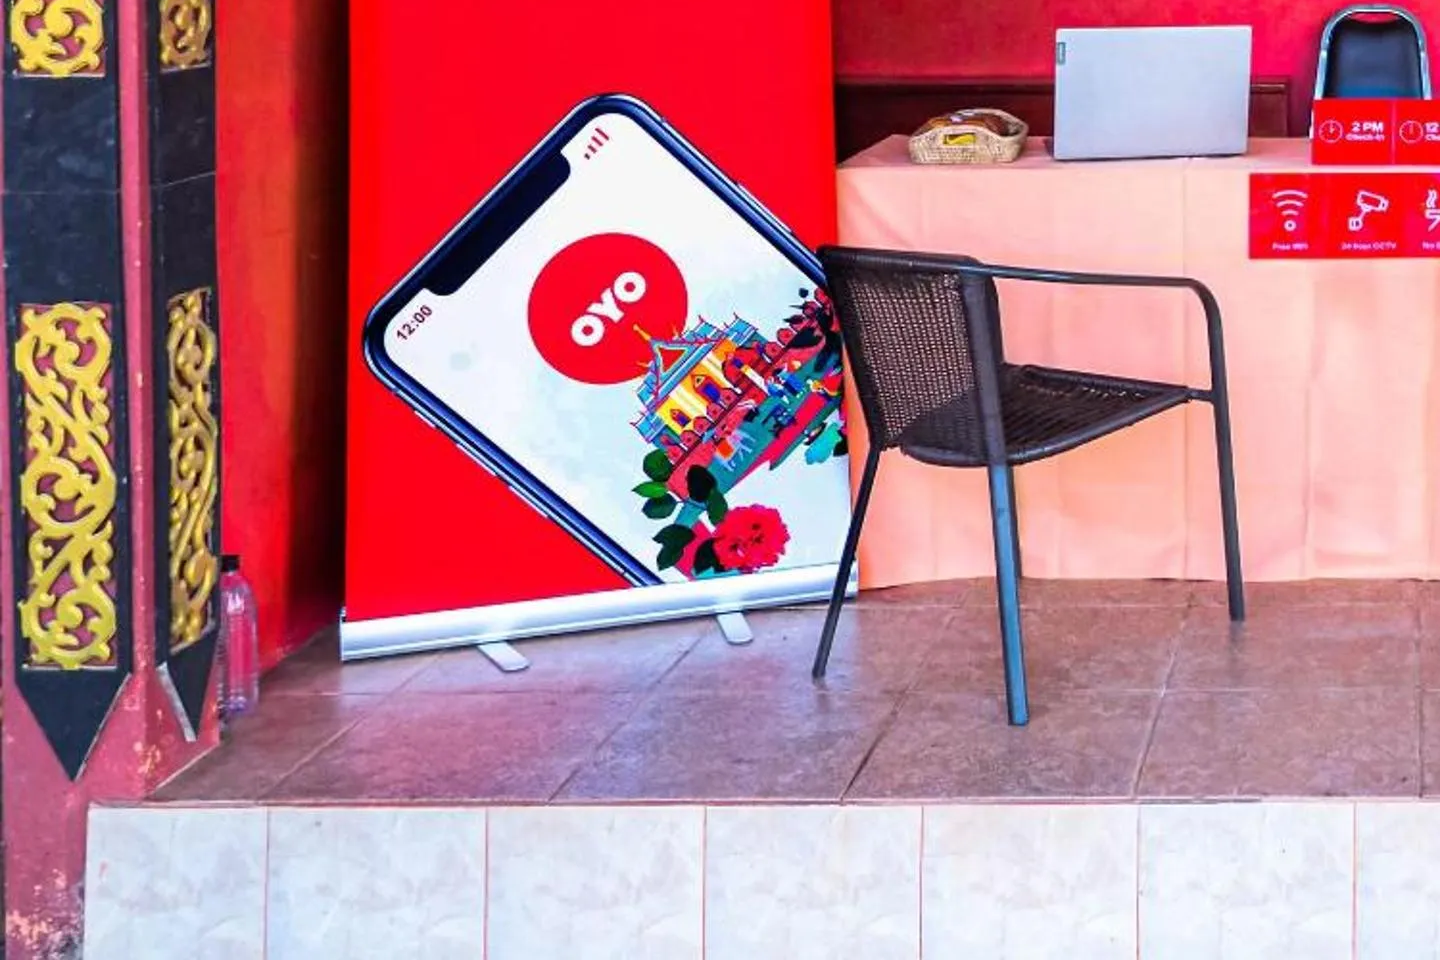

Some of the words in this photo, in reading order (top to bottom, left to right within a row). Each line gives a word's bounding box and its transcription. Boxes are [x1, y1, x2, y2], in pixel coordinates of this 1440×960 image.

[1352, 122, 1361, 132] 2
[1363, 122, 1384, 132] PM
[1425, 122, 1439, 132] 12
[570, 270, 647, 347] OYO
[396, 304, 434, 342] 12:00
